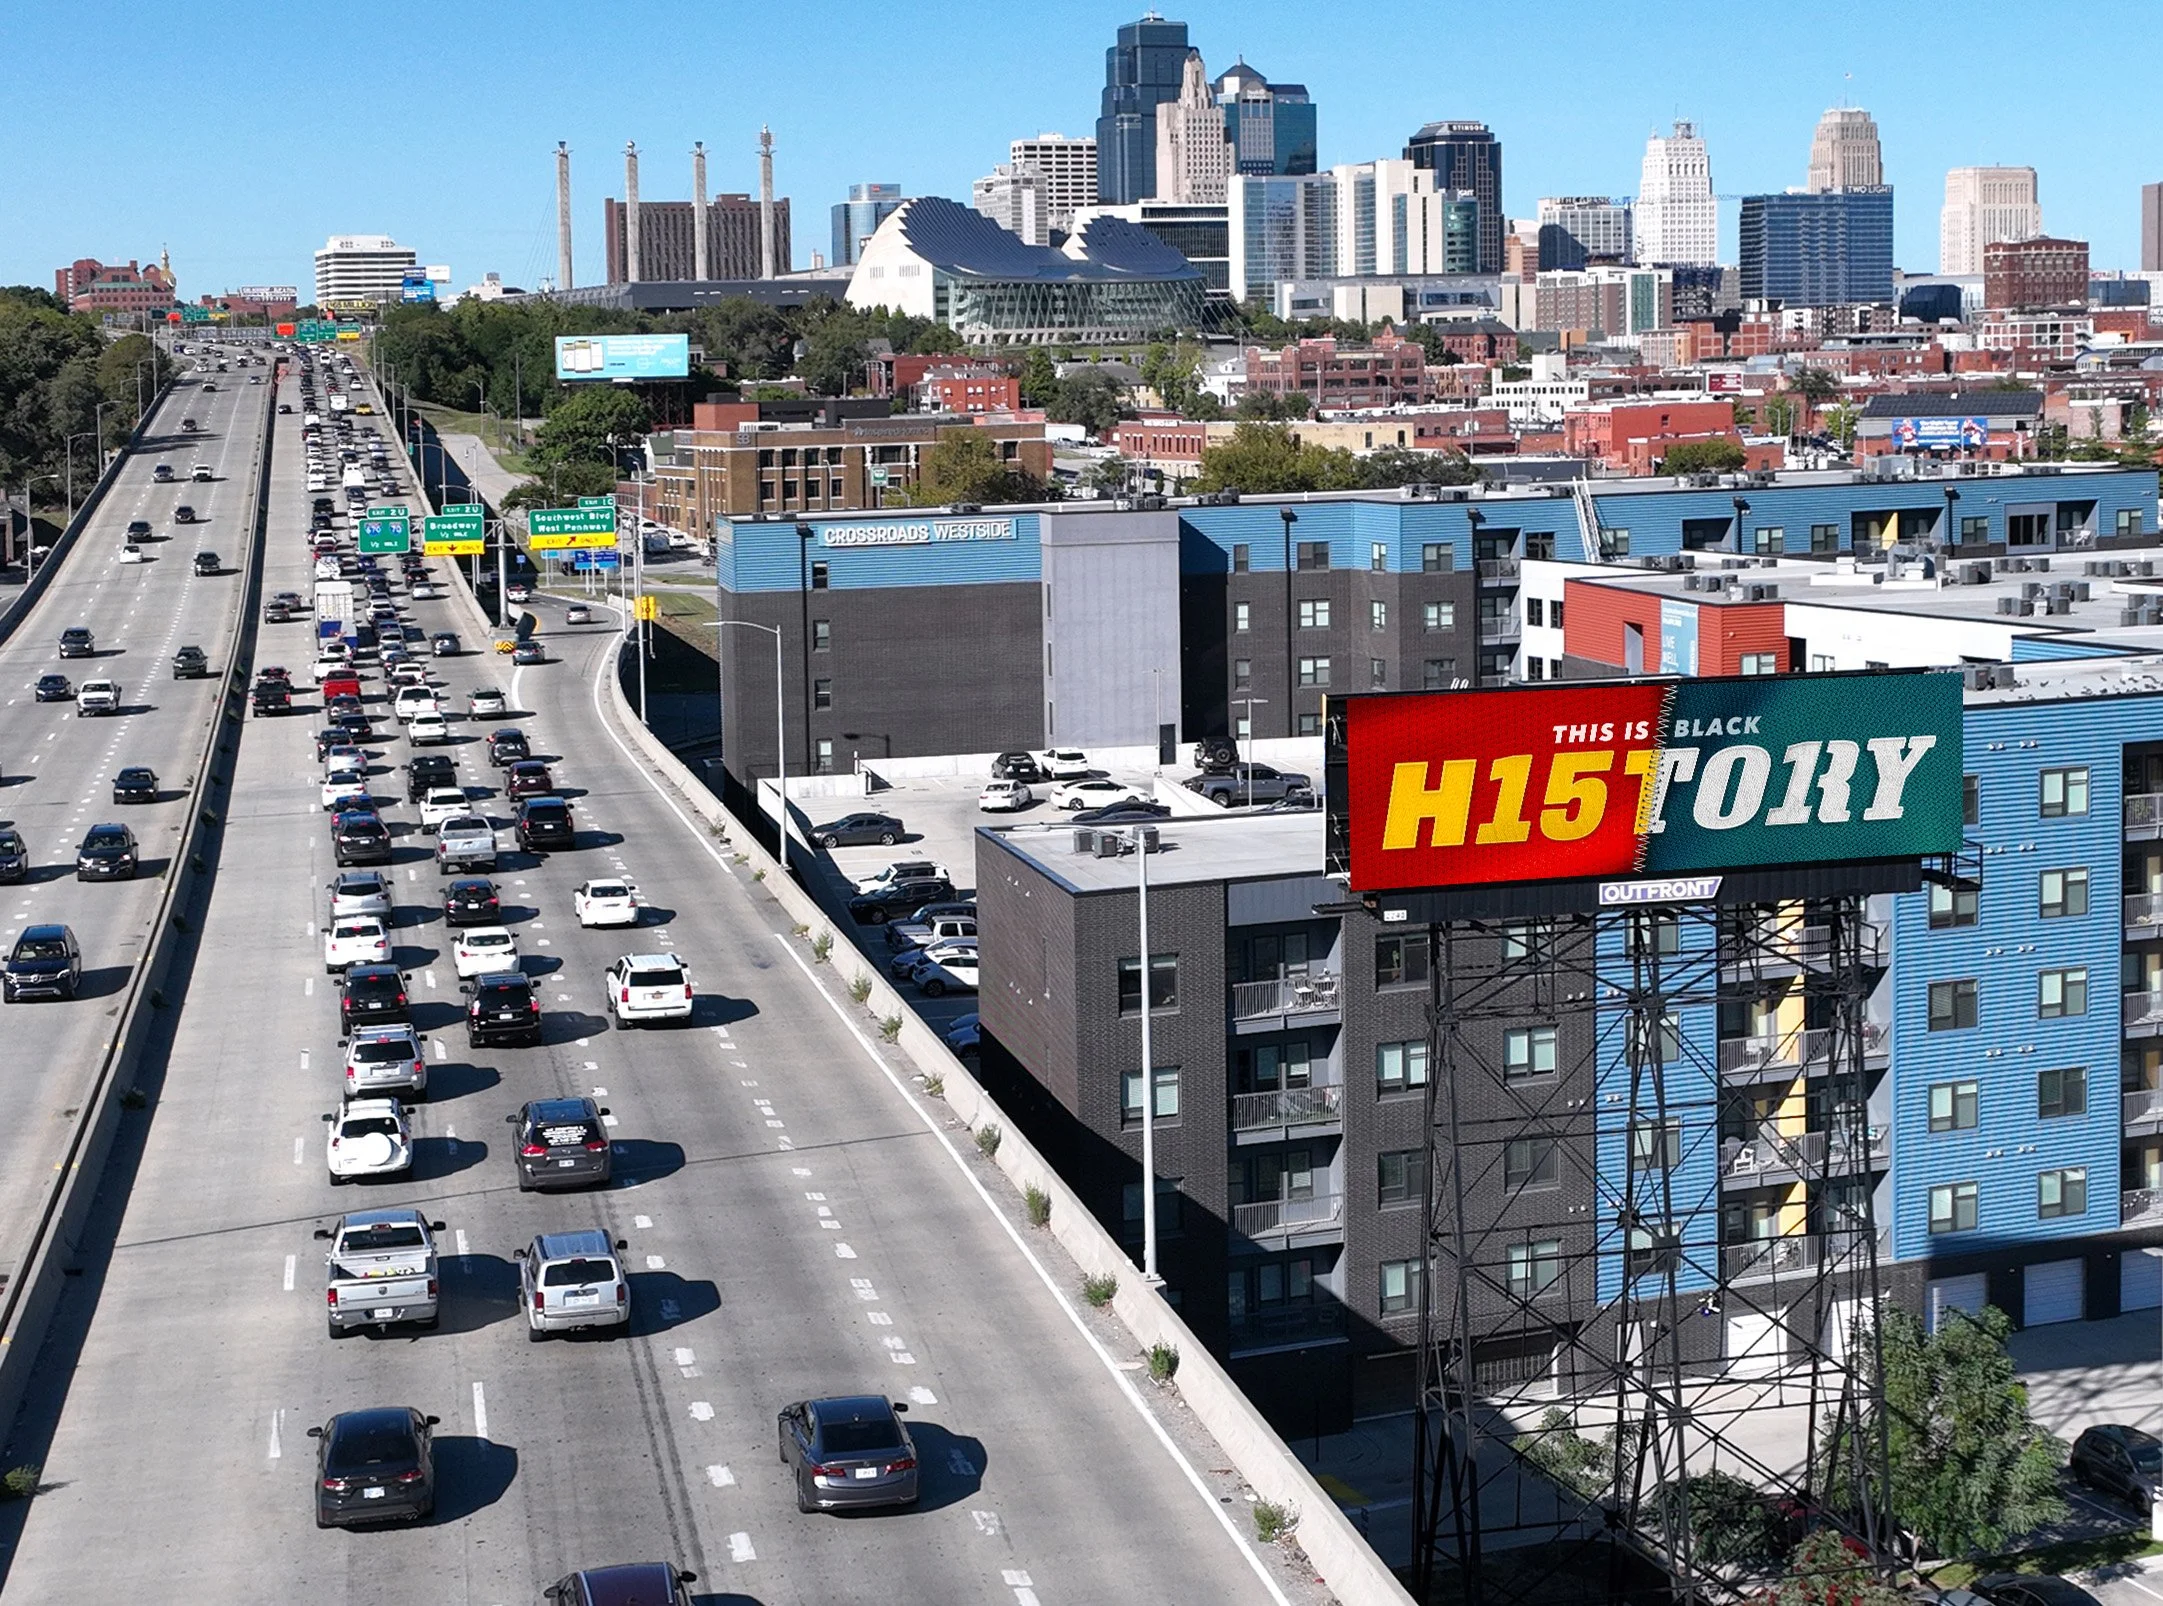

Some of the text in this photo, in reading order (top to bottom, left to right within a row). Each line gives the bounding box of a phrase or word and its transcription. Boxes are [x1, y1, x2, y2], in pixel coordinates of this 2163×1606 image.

[534, 512, 611, 522] Southwest Blvd
[390, 525, 402, 533] 70
[430, 522, 478, 530] Broadway
[538, 523, 608, 532] West Pennway
[824, 523, 1012, 544] CROSSROADS WESTSIDE
[1553, 715, 1763, 743] THIS IS BLACK
[1604, 880, 1716, 901] OUTFRONT
